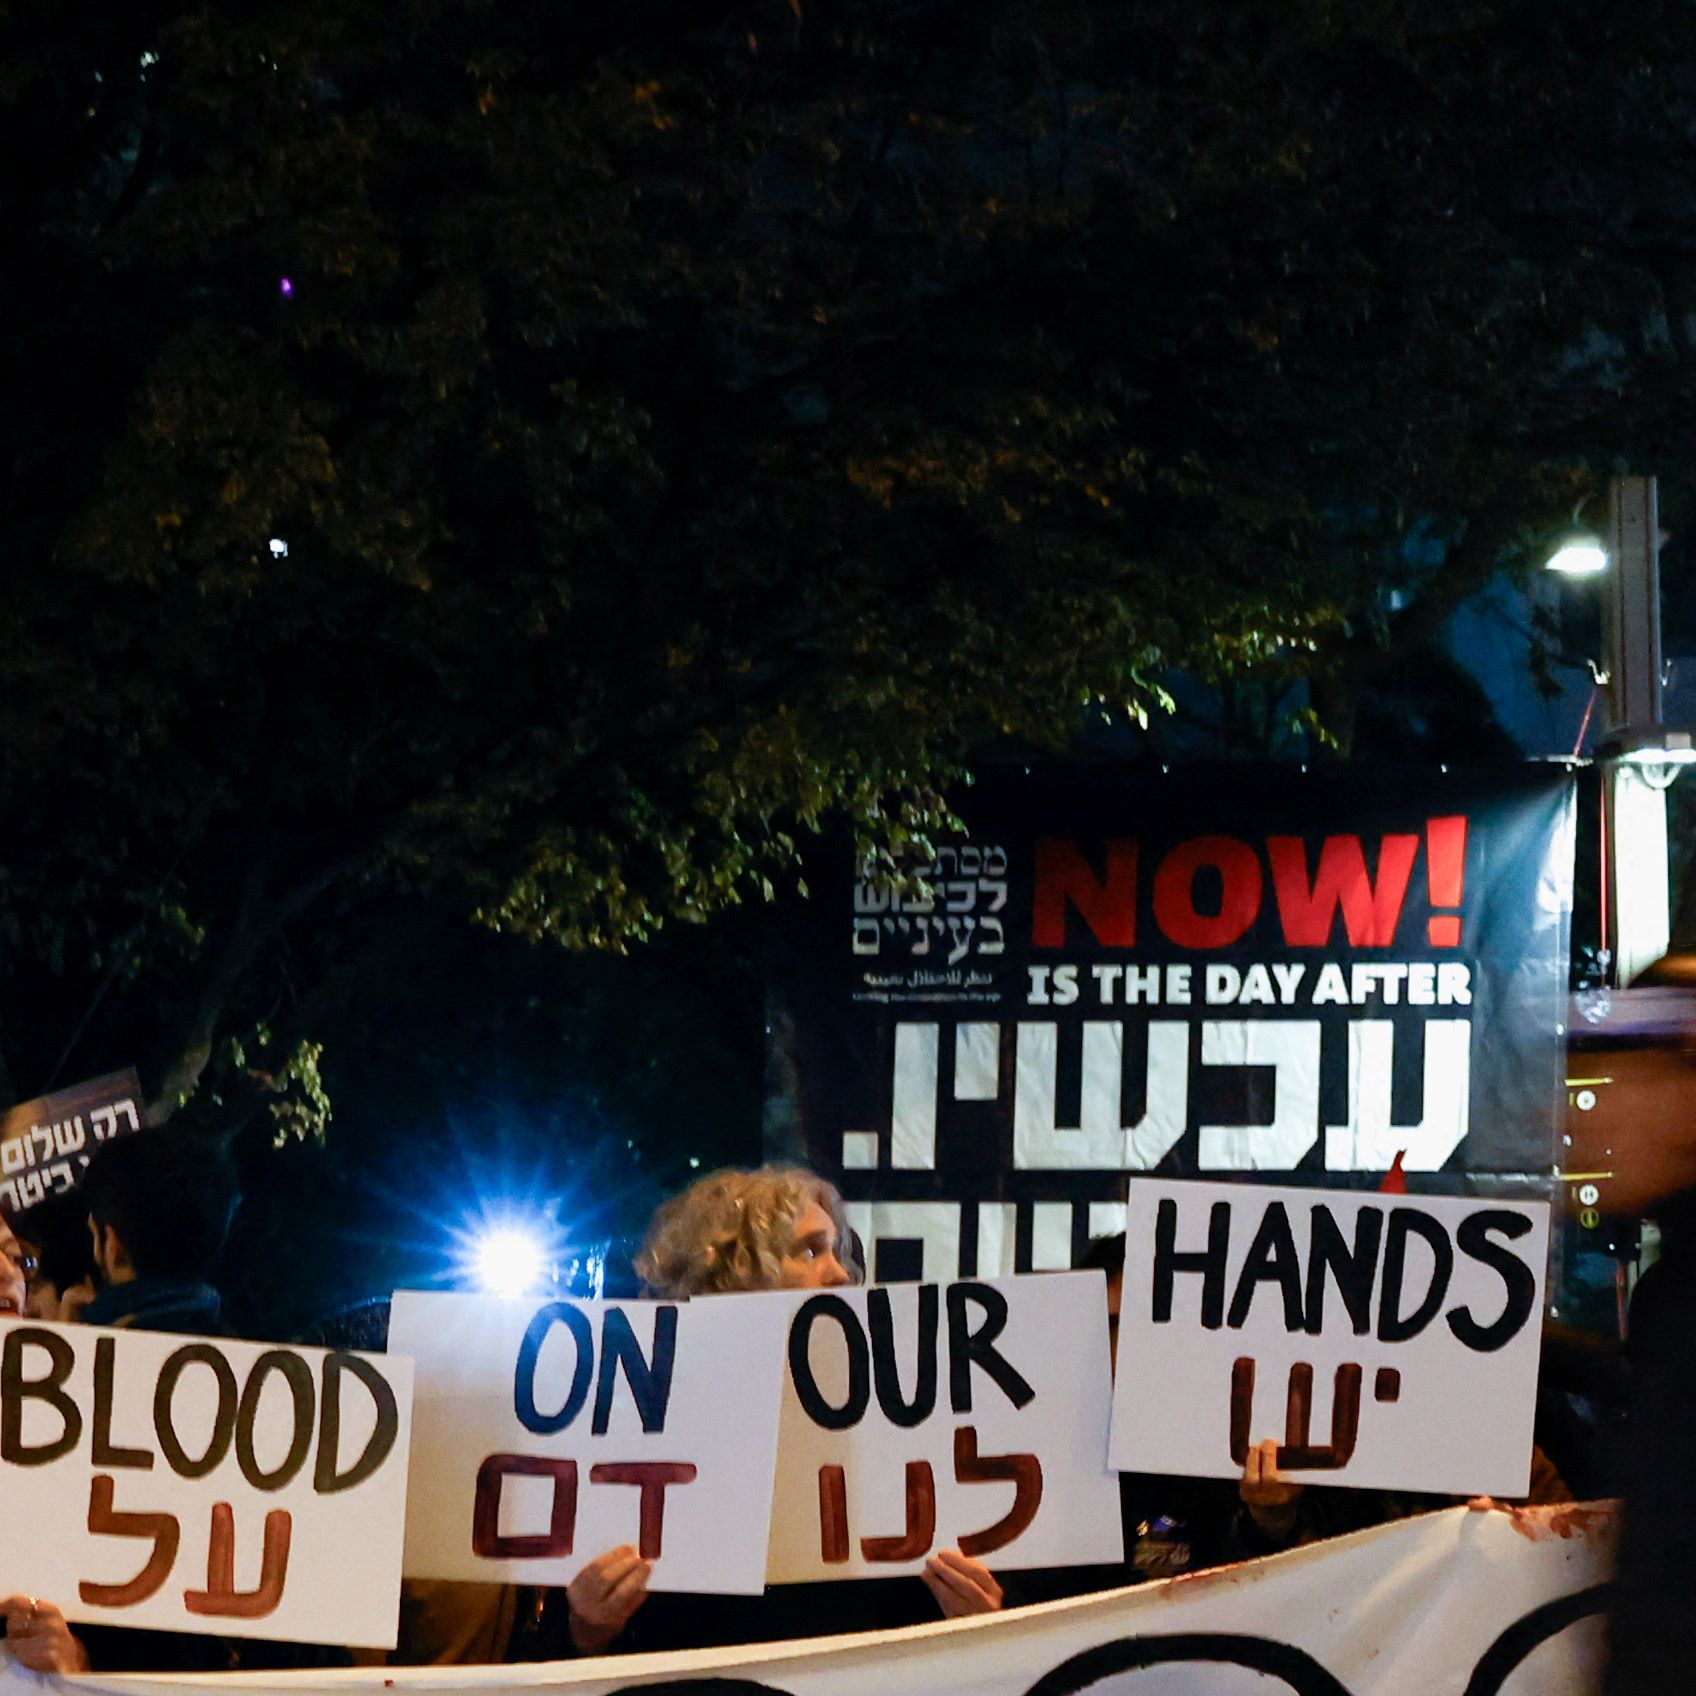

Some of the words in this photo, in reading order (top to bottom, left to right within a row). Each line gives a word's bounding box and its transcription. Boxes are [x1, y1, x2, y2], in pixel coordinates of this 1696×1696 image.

[852, 915, 1006, 966] בעיניים
[1032, 814, 1470, 949] NOW!
[1027, 964, 1082, 1006] IS
[1092, 964, 1192, 1006] THE
[1204, 963, 1307, 1006] DAY
[1312, 962, 1473, 1006] AFTER
[0, 1115, 86, 1174] שלום
[89, 1098, 141, 1140] רק
[842, 1018, 1472, 1173] עכשיו.
[1150, 1198, 1537, 1354] HANDS
[0, 1326, 399, 1495] BLOOD
[513, 1302, 679, 1437] ON
[787, 1281, 1036, 1431] OUR
[1230, 1356, 1402, 1472] יש
[78, 1475, 293, 1620] על
[472, 1452, 698, 1561] דם
[818, 1425, 1044, 1565] לנו
